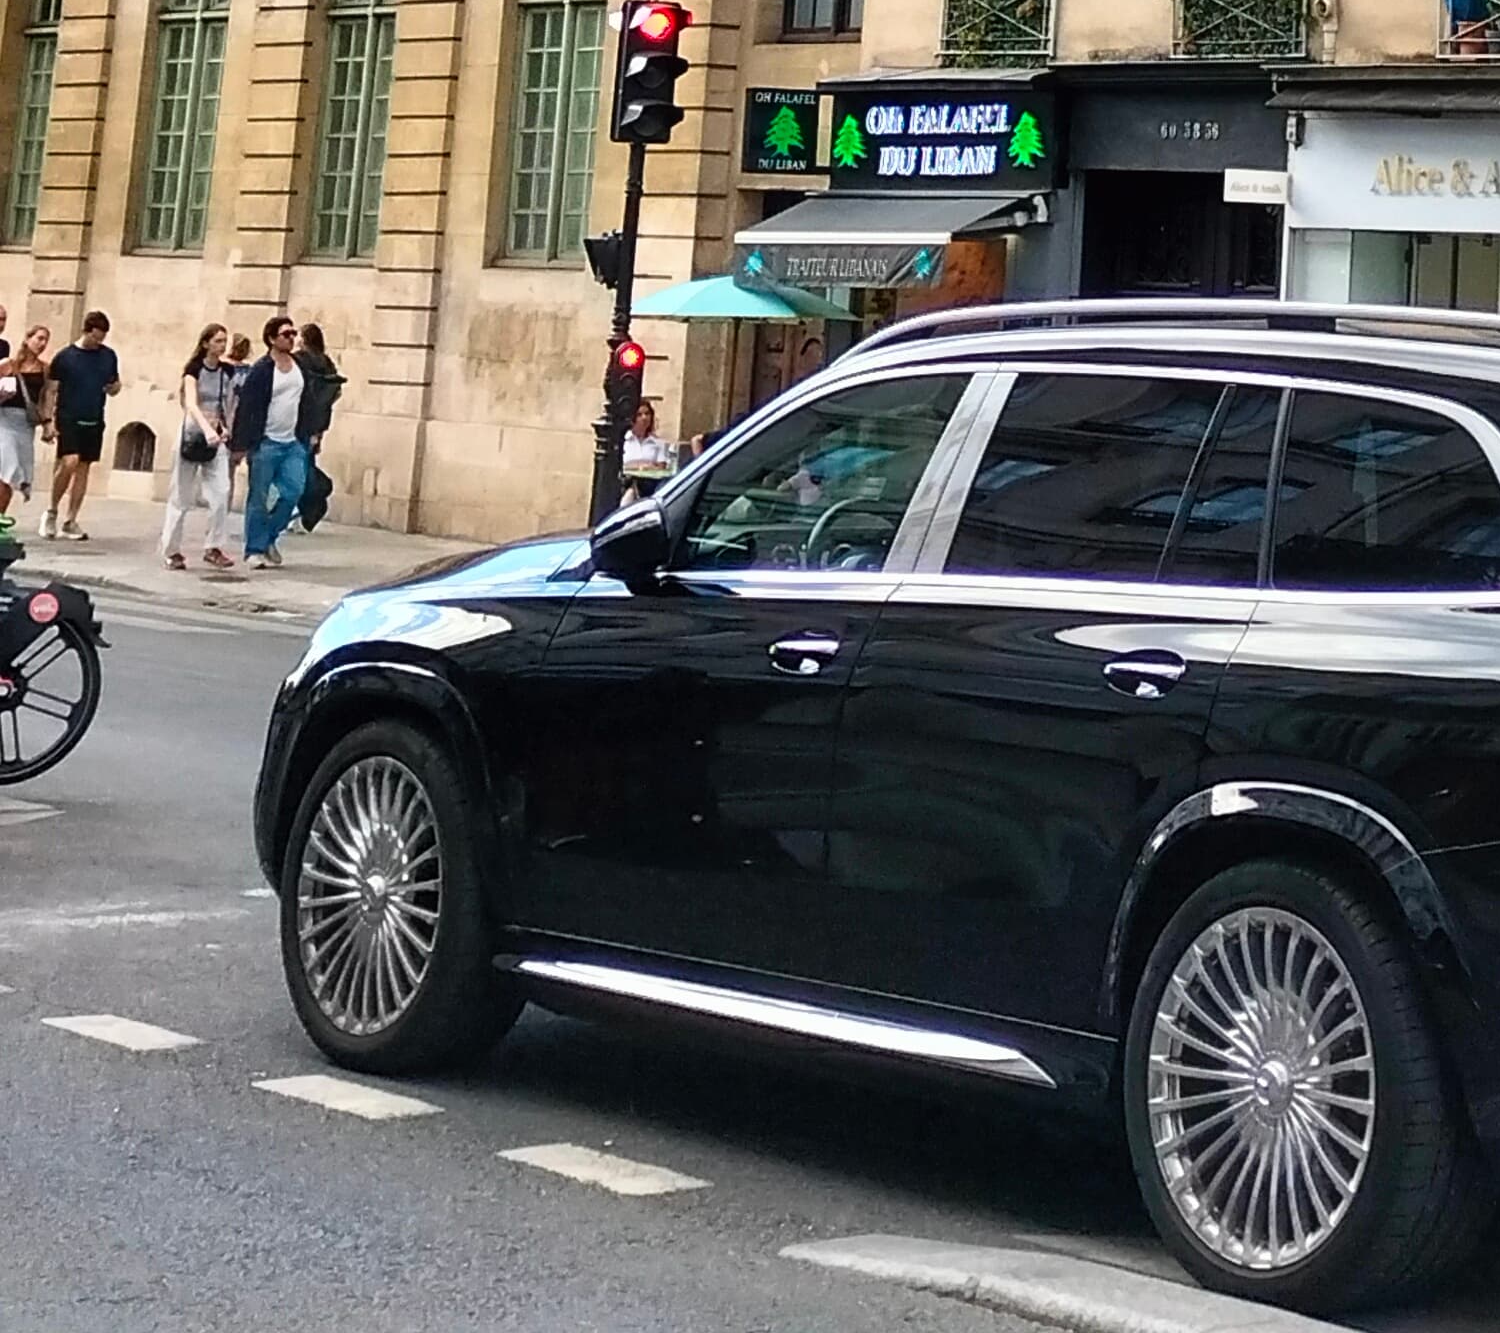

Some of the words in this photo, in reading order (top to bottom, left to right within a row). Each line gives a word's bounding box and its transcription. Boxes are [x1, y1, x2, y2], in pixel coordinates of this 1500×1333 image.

[755, 91, 772, 103] OH
[774, 92, 817, 105] FALAFEL
[865, 105, 905, 134] OH
[907, 102, 1012, 134] FALAFEL
[758, 157, 774, 170] DU
[775, 158, 808, 171] LIBAN
[876, 145, 918, 176] DU
[919, 144, 998, 176] LIBAN
[1370, 152, 1446, 196] Alice
[1449, 156, 1477, 198] &
[786, 257, 838, 277] TRAITEUR
